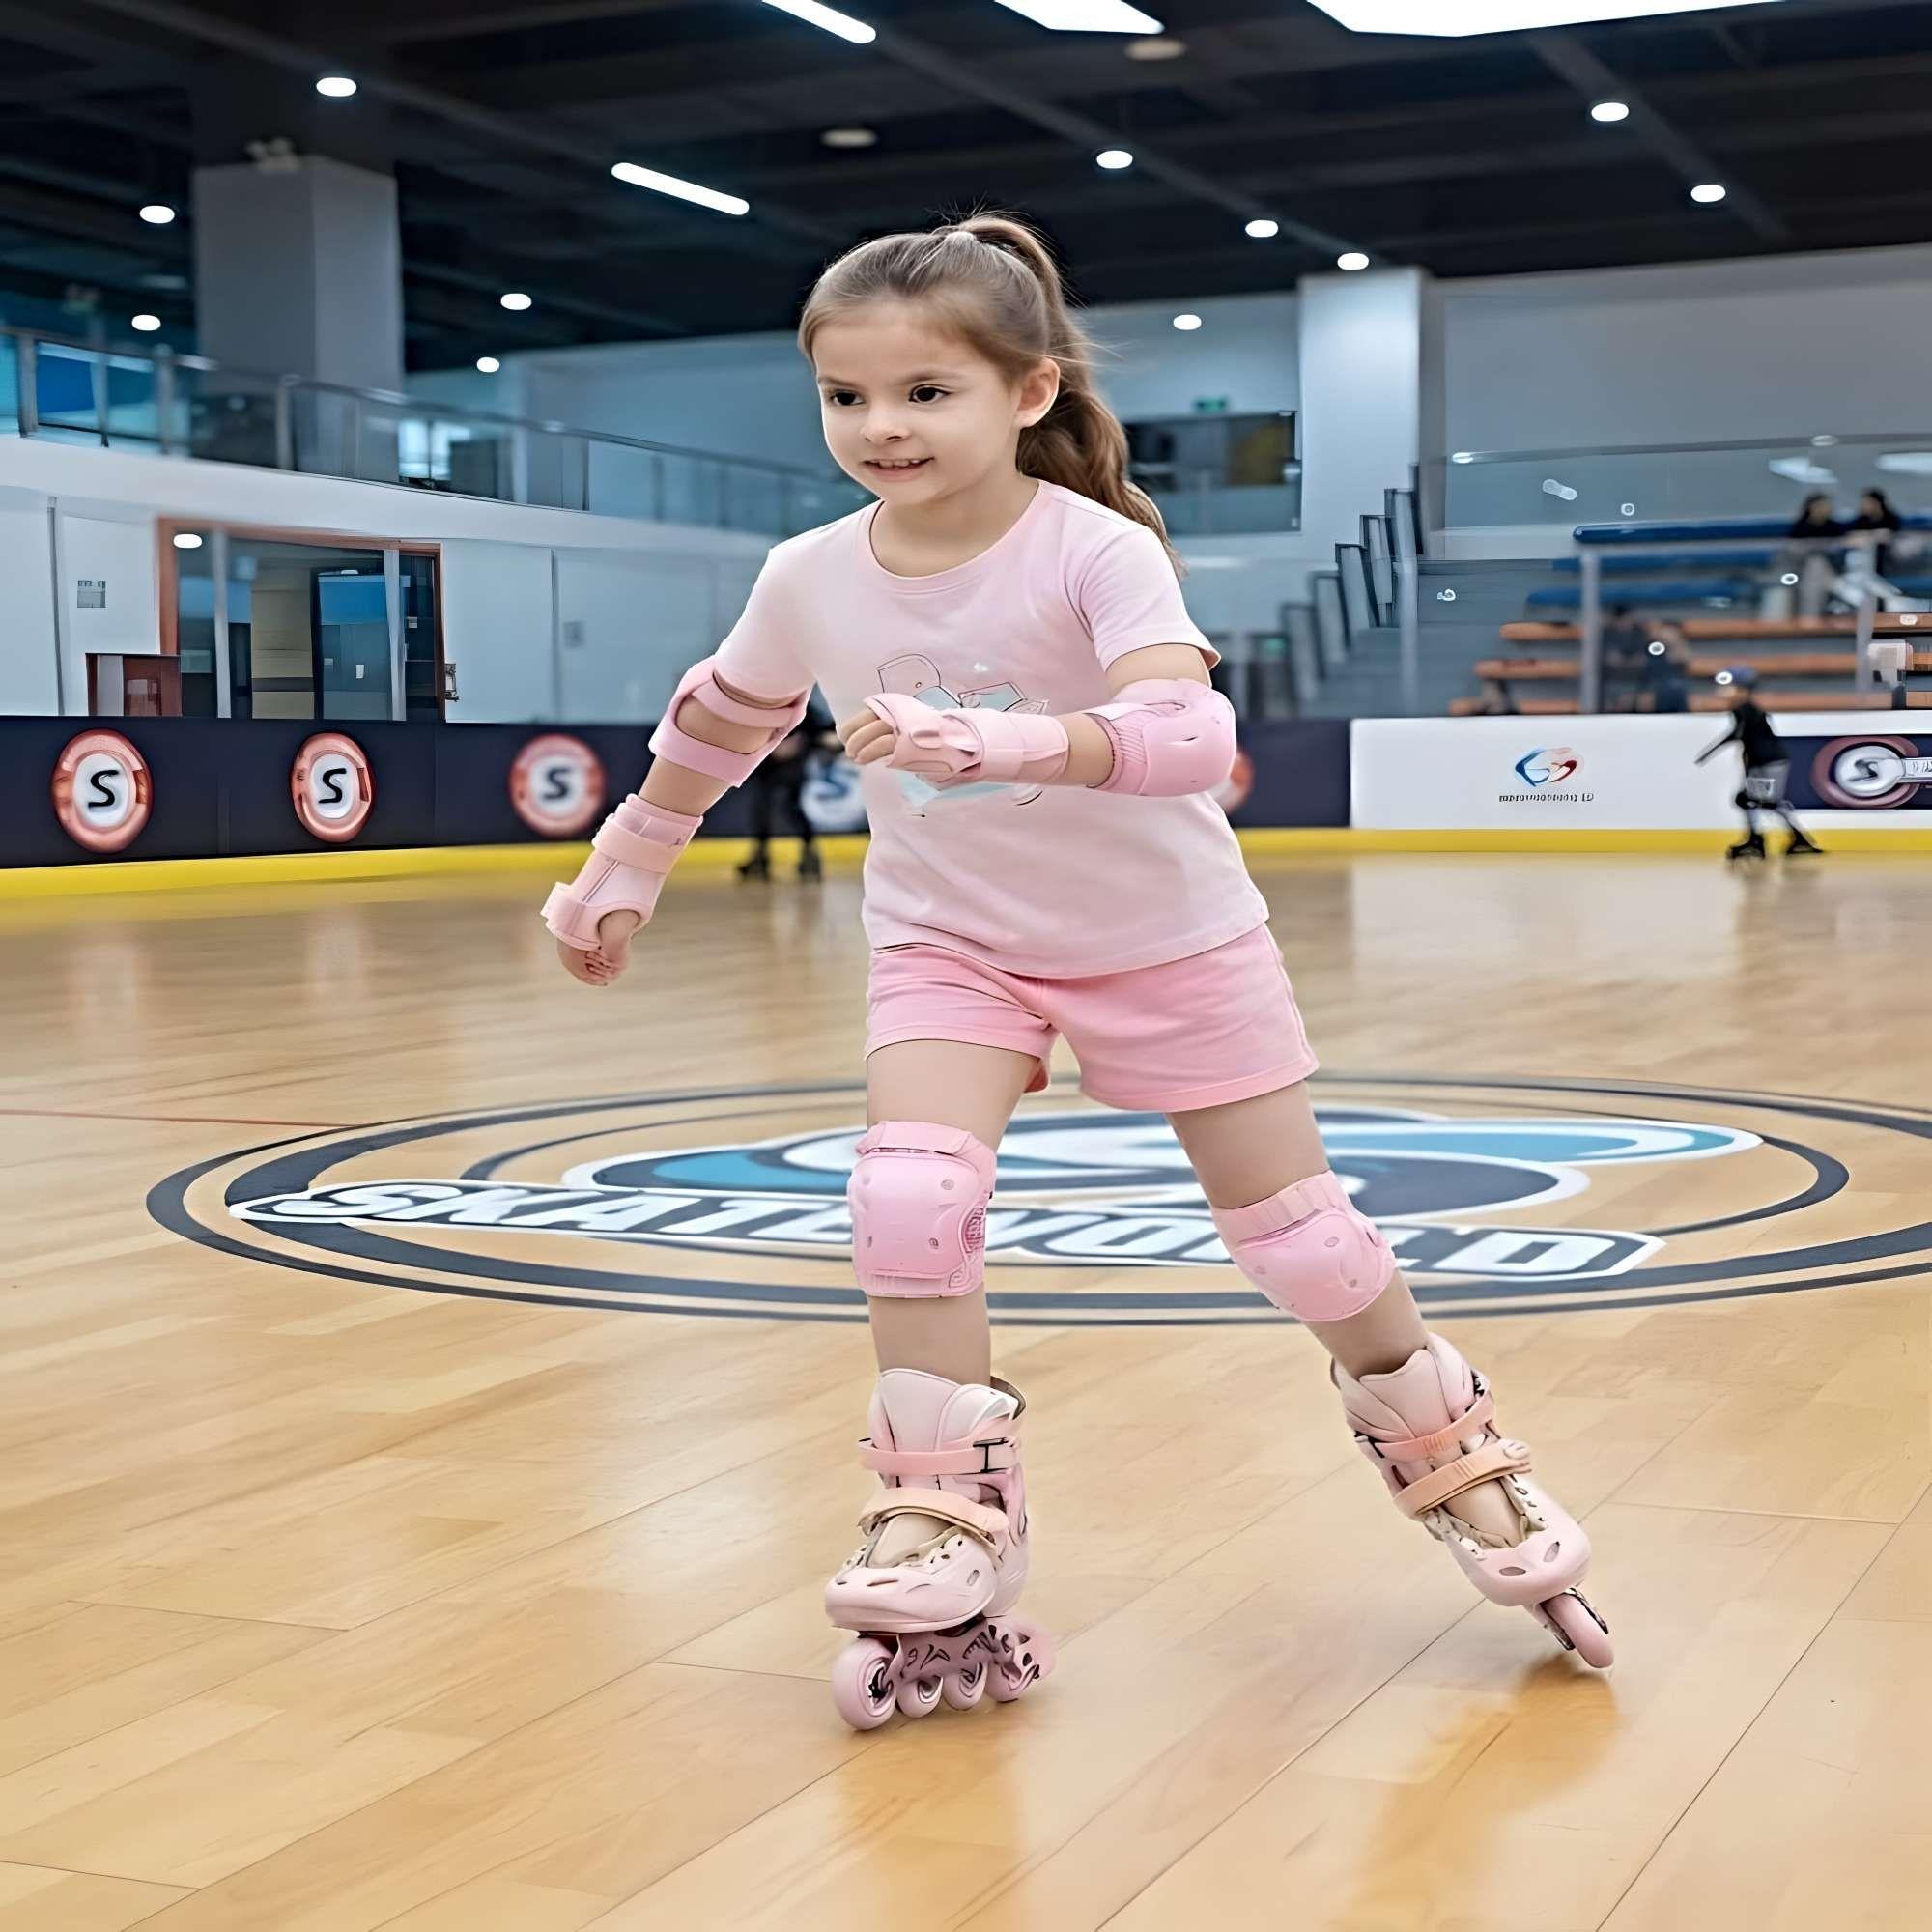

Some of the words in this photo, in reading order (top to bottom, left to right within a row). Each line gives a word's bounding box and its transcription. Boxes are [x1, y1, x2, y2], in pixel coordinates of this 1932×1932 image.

[88, 769, 120, 809] S
[318, 767, 347, 804] S
[541, 766, 571, 801] S
